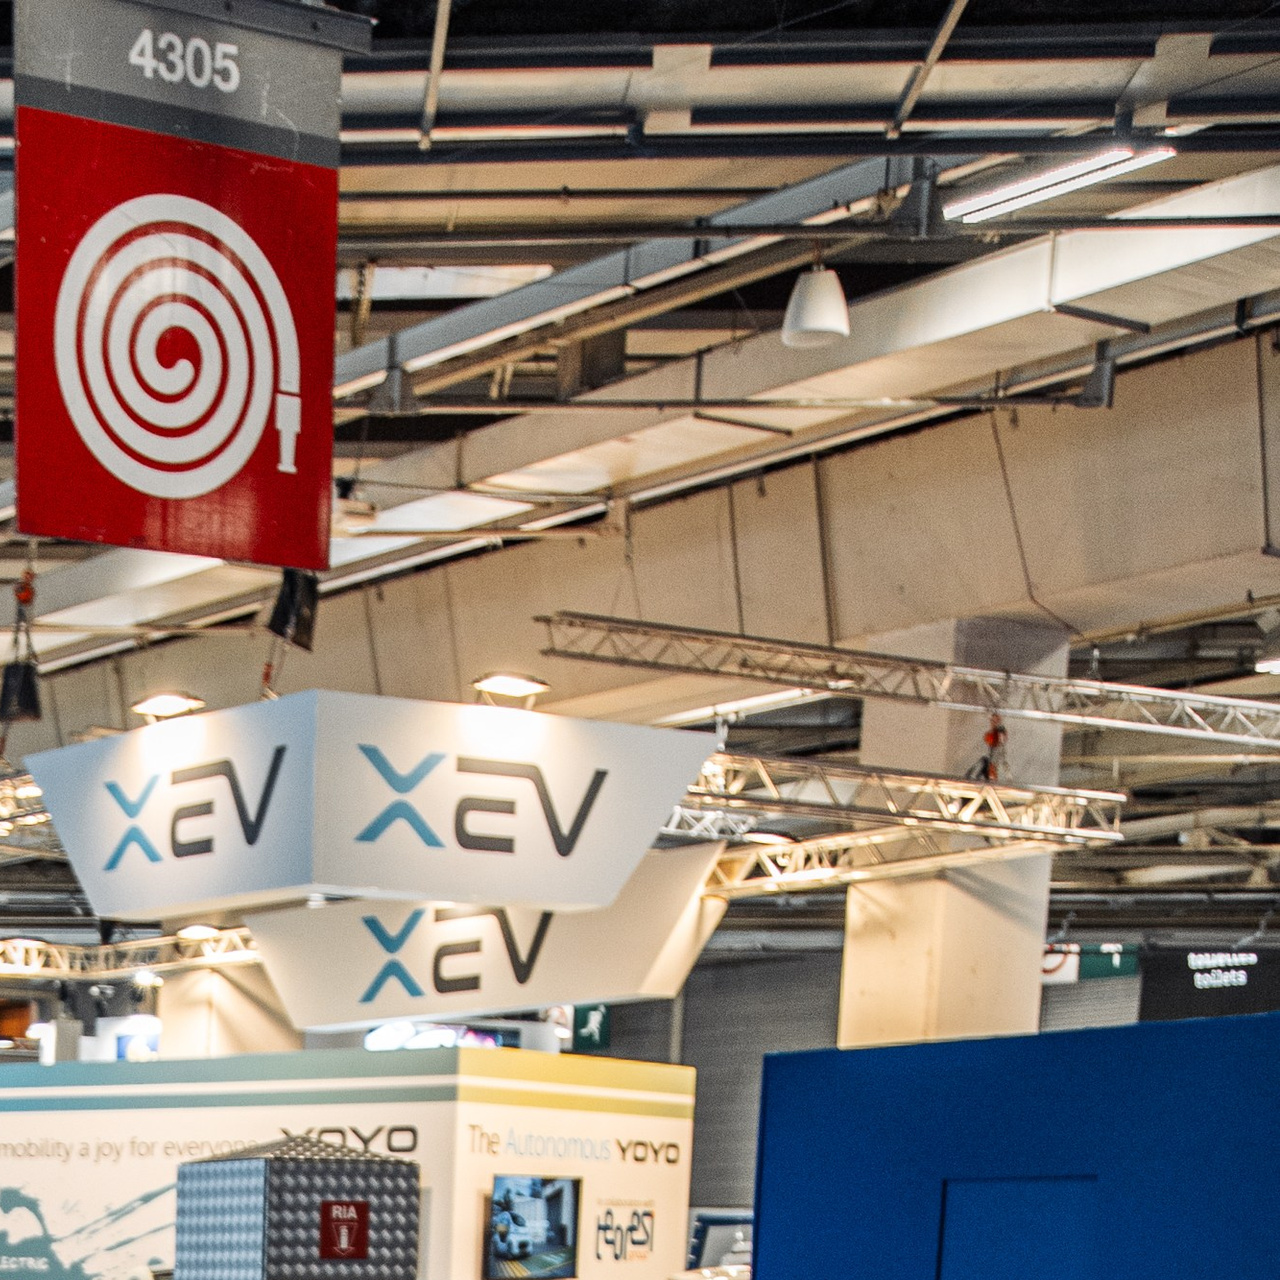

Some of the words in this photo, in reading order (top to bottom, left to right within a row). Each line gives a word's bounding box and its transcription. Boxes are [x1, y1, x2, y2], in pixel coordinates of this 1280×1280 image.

[128, 28, 241, 93] 4305
[104, 744, 287, 872] XEV
[354, 743, 609, 857] XEV
[358, 907, 554, 1003] XEV
[1194, 969, 1248, 989] toilets
[78, 1141, 90, 1157] a
[93, 1138, 122, 1164] joy
[130, 1137, 160, 1156] for
[469, 1124, 501, 1156] The
[505, 1127, 612, 1161] Autonomous
[615, 1138, 680, 1165] YOYO
[331, 1204, 358, 1220] RIA
